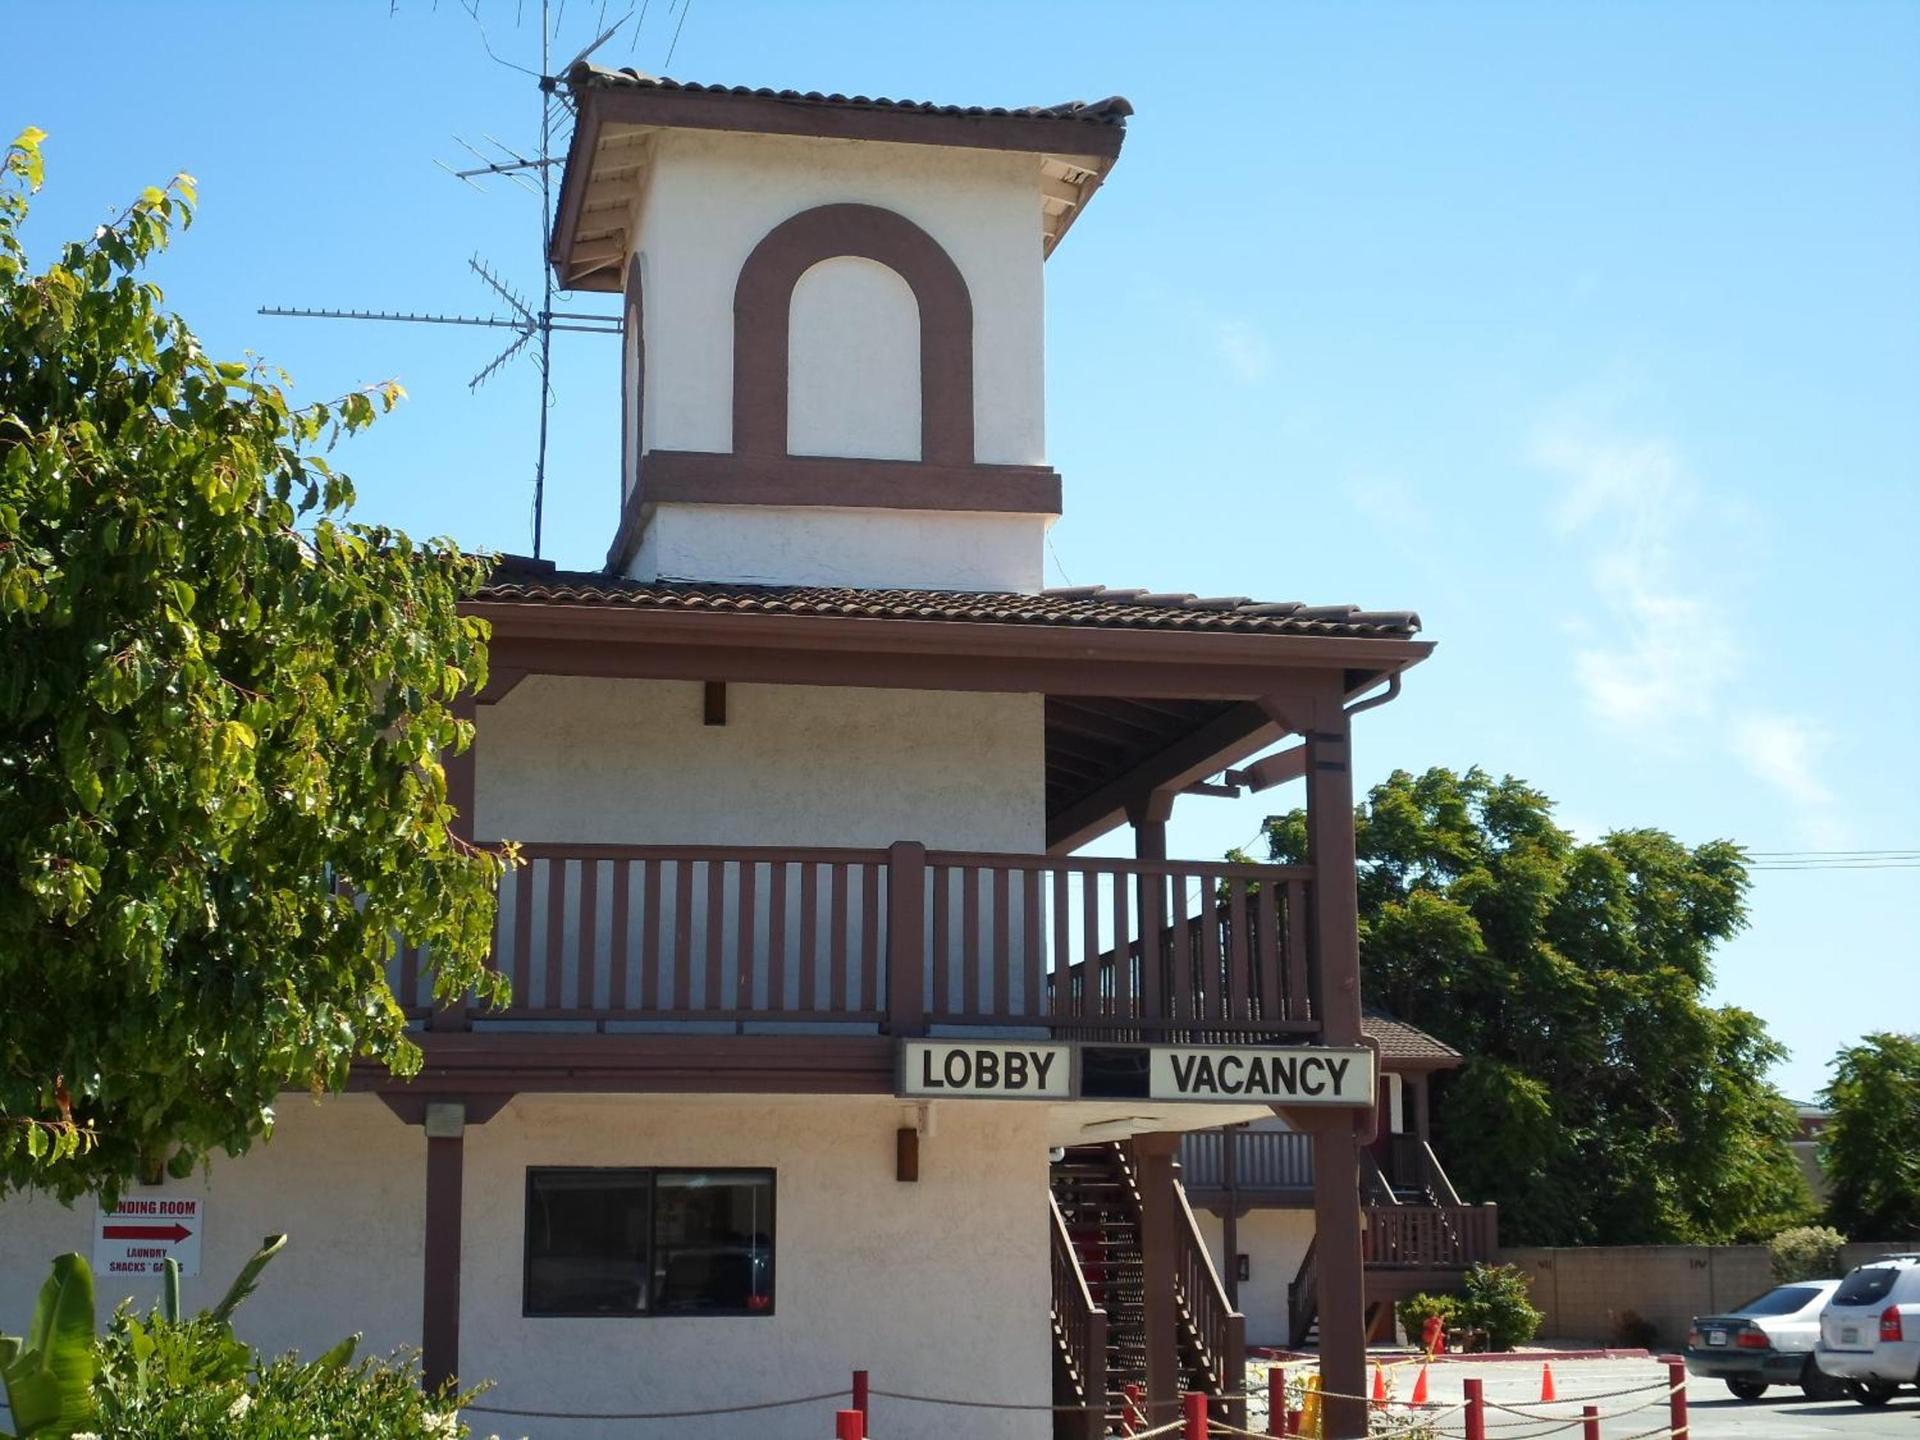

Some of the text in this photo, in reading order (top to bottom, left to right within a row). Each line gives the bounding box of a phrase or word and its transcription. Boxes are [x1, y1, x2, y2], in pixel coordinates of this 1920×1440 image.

[922, 1049, 1055, 1091] LOBBY
[1170, 1054, 1350, 1097] VACANCY
[115, 1201, 196, 1215] NDING ROOM
[126, 1248, 167, 1258] LAUNDRY
[109, 1262, 184, 1273] SNACKS GAS
